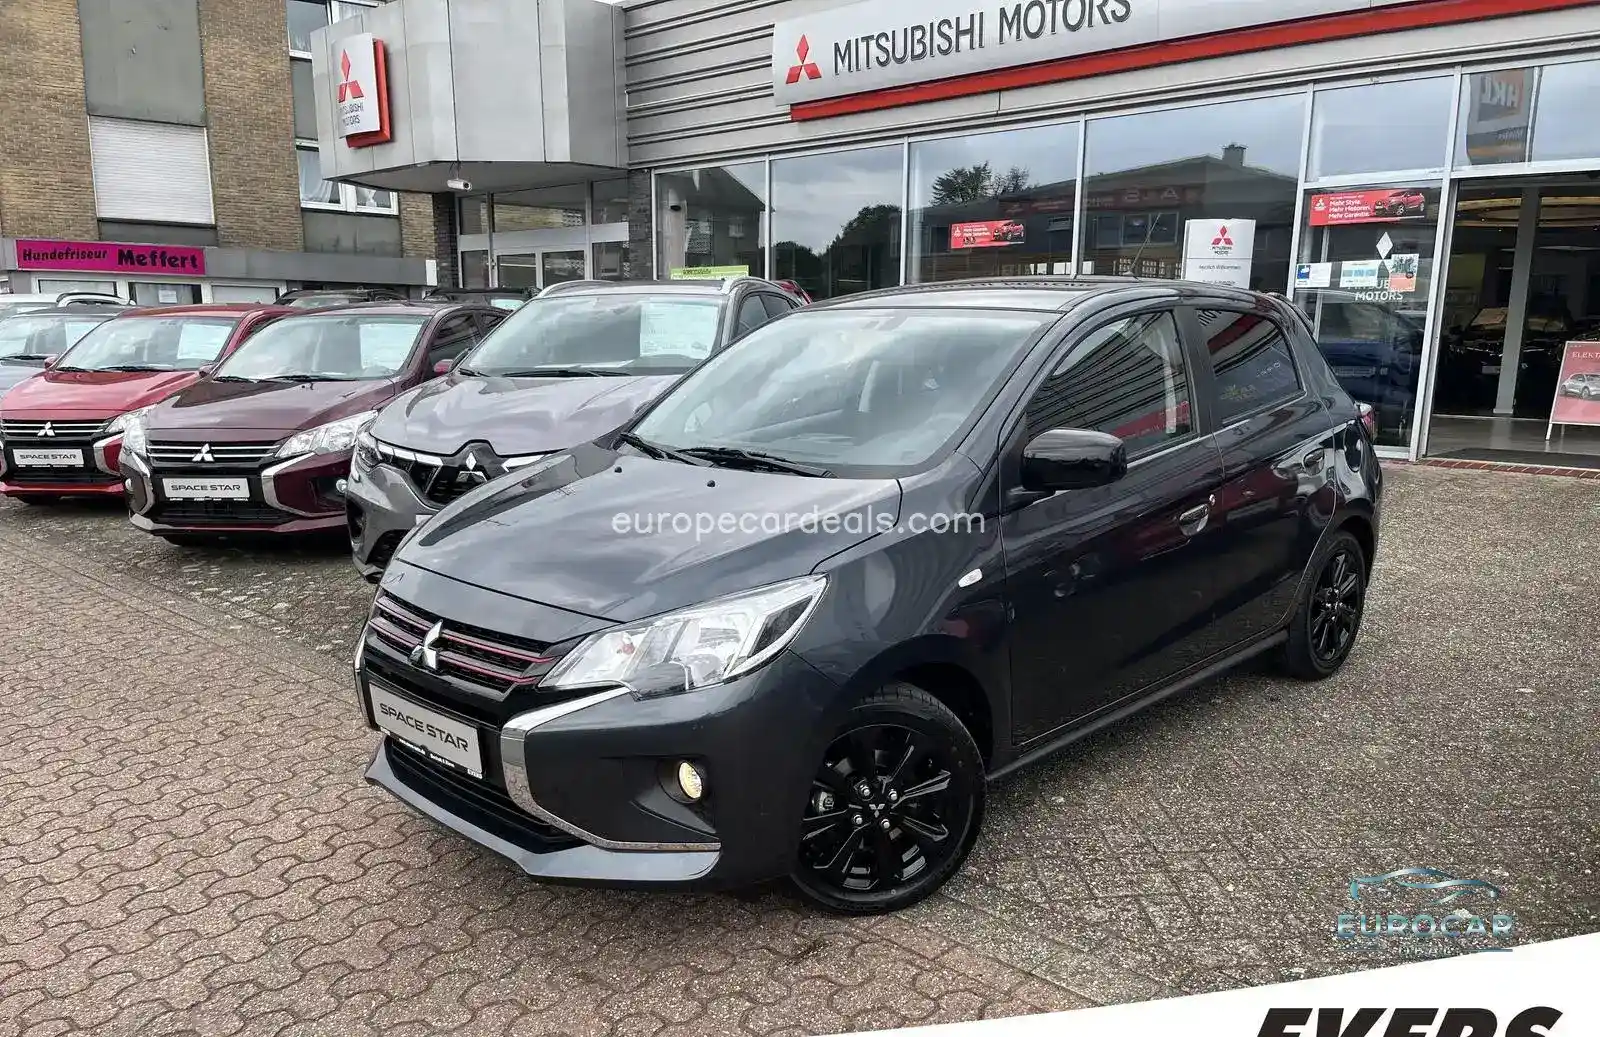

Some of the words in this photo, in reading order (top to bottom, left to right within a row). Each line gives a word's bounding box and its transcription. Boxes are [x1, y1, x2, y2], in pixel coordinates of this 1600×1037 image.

[833, 11, 986, 76] MITSUBISHI
[999, 0, 1132, 44] MOTORS
[22, 246, 107, 261] Hundefriseur
[117, 250, 198, 268] Meffert
[1355, 291, 1403, 301] MOTORS
[380, 702, 425, 733] SPACE
[426, 723, 469, 752] STAR
